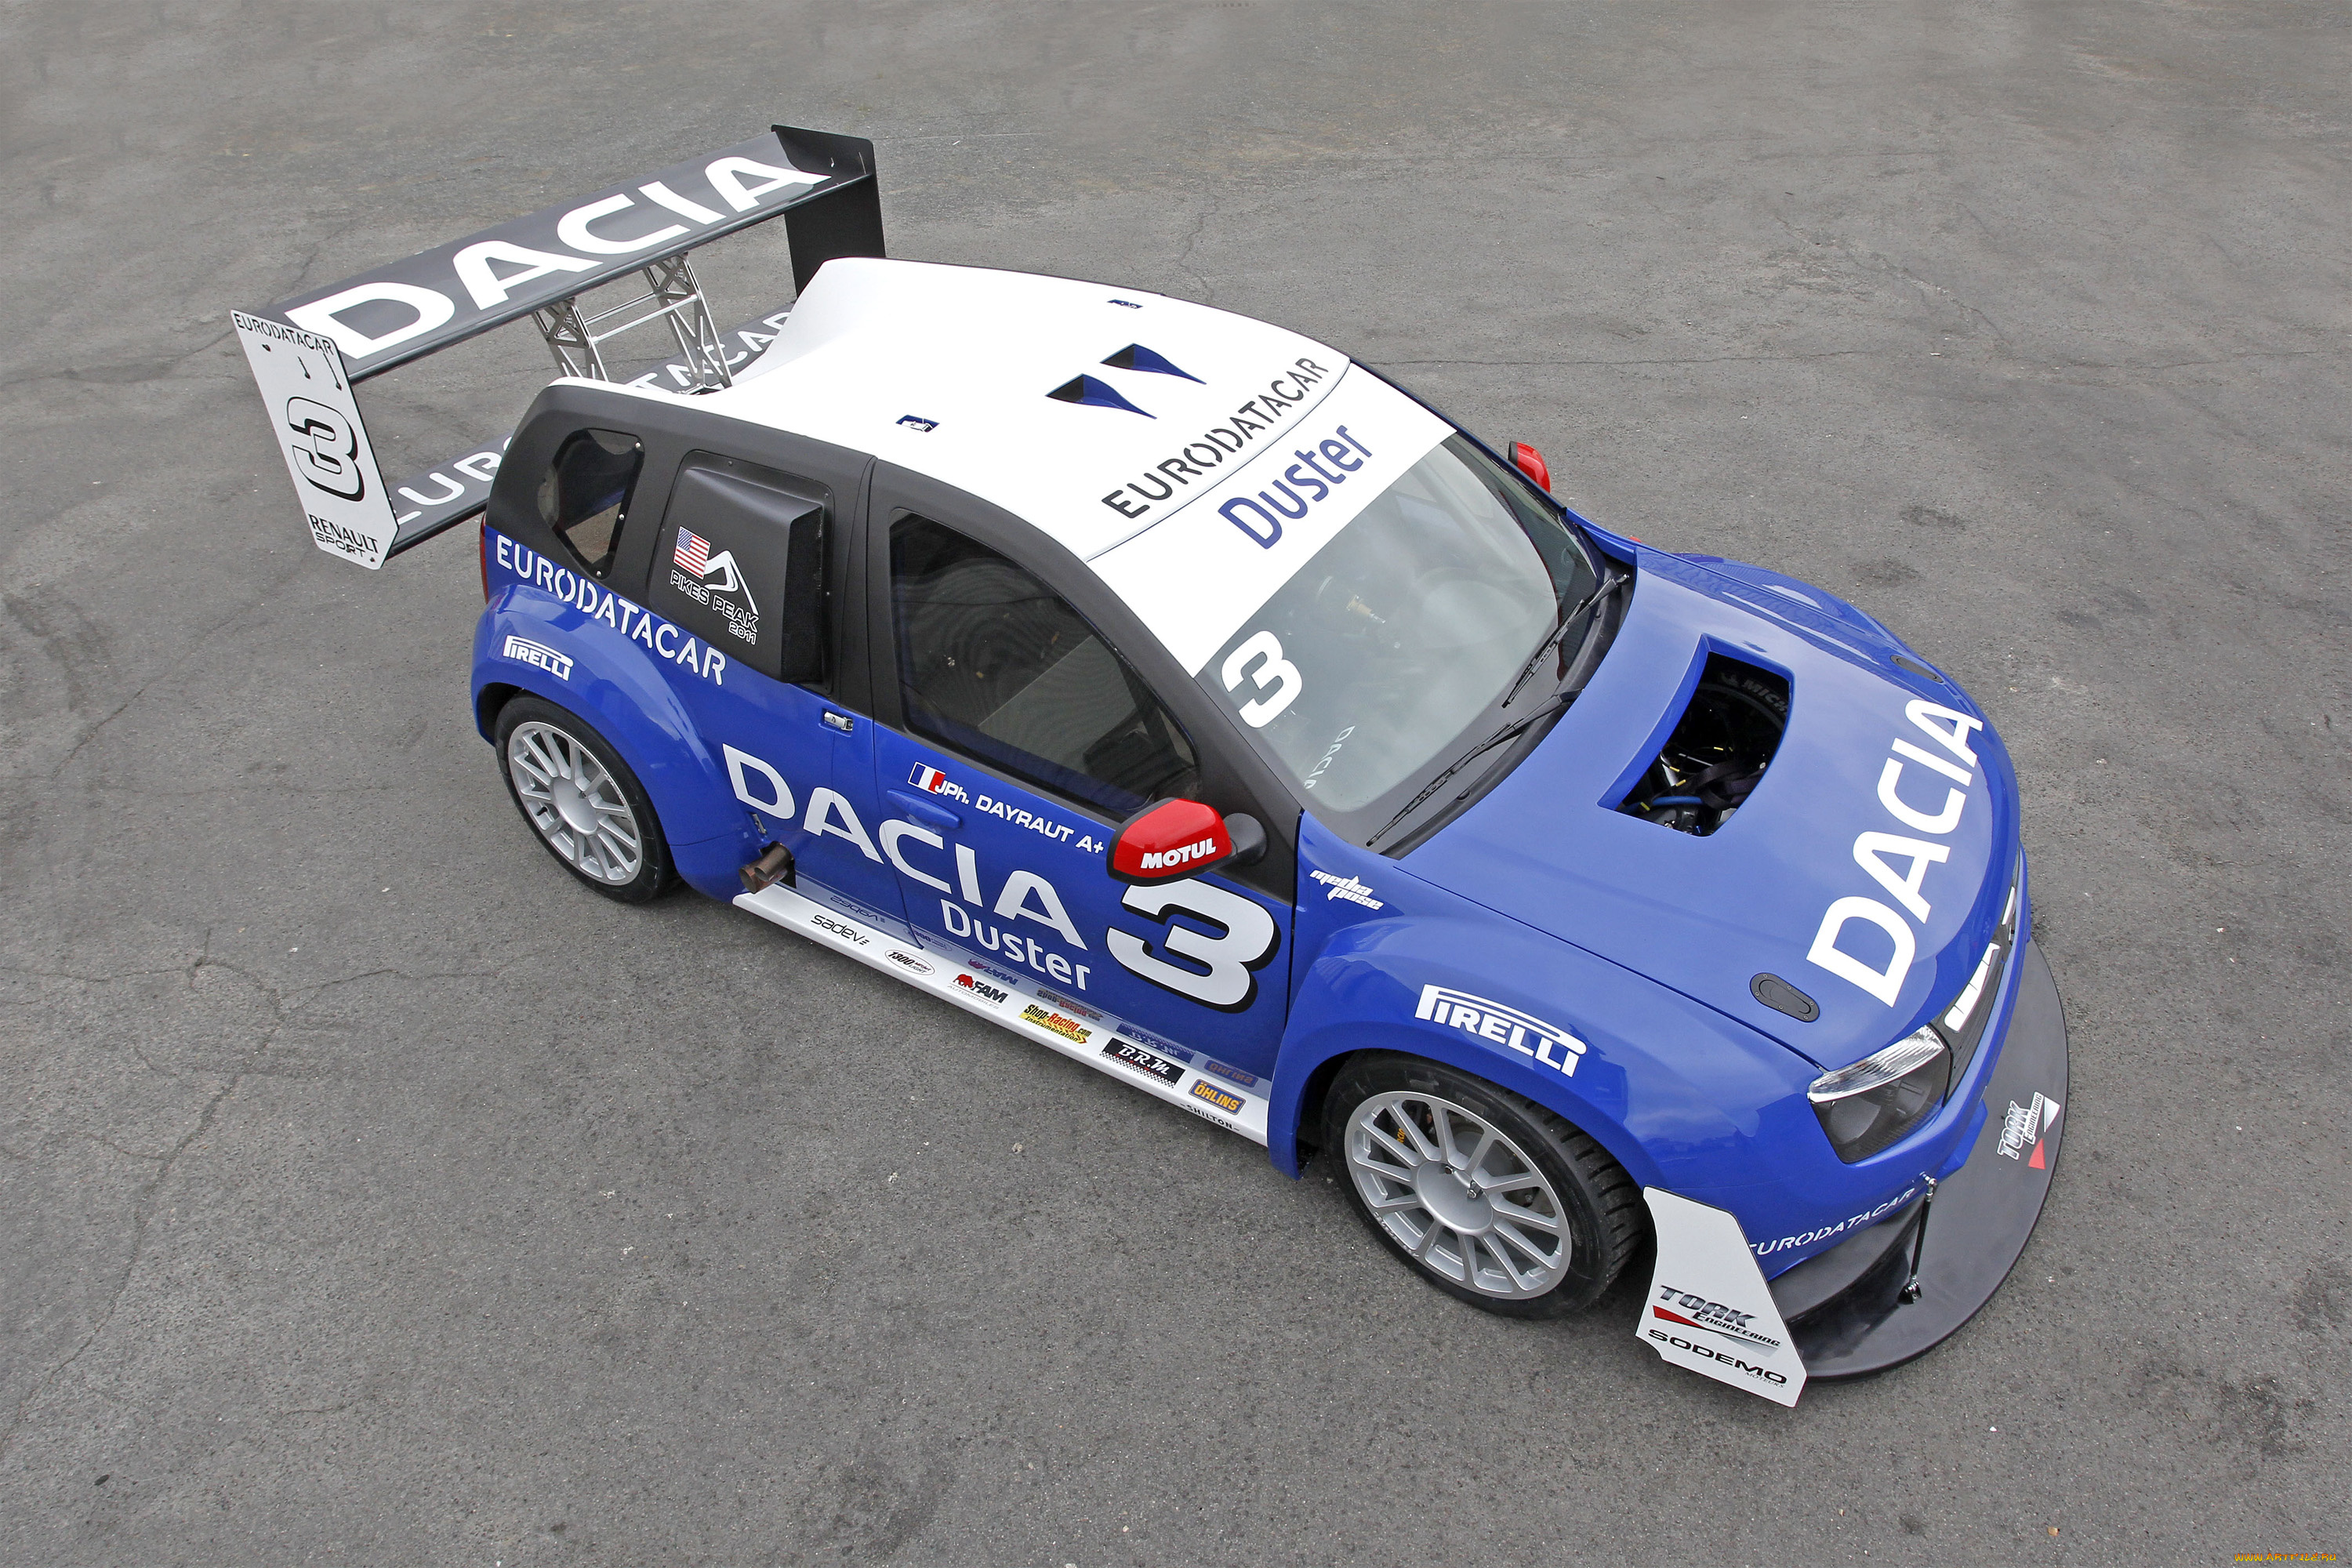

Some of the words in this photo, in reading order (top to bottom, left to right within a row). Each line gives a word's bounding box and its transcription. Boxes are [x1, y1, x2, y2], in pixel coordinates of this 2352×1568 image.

[285, 156, 832, 360] DACIA
[234, 314, 335, 355] EURODATACAR
[287, 397, 365, 502] 3
[1101, 358, 1329, 519] EURODATACAR
[1218, 425, 1373, 549] Duster
[309, 514, 379, 554] RENAULT
[315, 532, 365, 557] SPORT
[496, 535, 728, 686] EURODATACAR
[670, 570, 710, 606] PIKES
[713, 595, 760, 633] PEAK
[503, 635, 574, 681] PIRELLI
[728, 622, 757, 645] 2011
[1221, 630, 1303, 728] 3
[722, 743, 1088, 951] DACIA
[935, 780, 970, 805] JPh.
[975, 794, 1075, 843] DAYRAUT
[1076, 835, 1105, 855] A+
[1140, 837, 1217, 870] MOTUL
[1806, 699, 1984, 1008] DACIA
[940, 899, 1091, 990] Duster
[1106, 878, 1281, 1014] 3
[971, 981, 1009, 1004] FAM
[1024, 1016, 1079, 1042] Instrumentation
[1414, 983, 1588, 1078] PIRELLI
[1194, 1082, 1242, 1113] ÖHLINS
[1997, 1100, 2031, 1160] TORK
[1661, 1285, 1758, 1329] TORK
[1648, 1329, 1788, 1385] SODEMO
